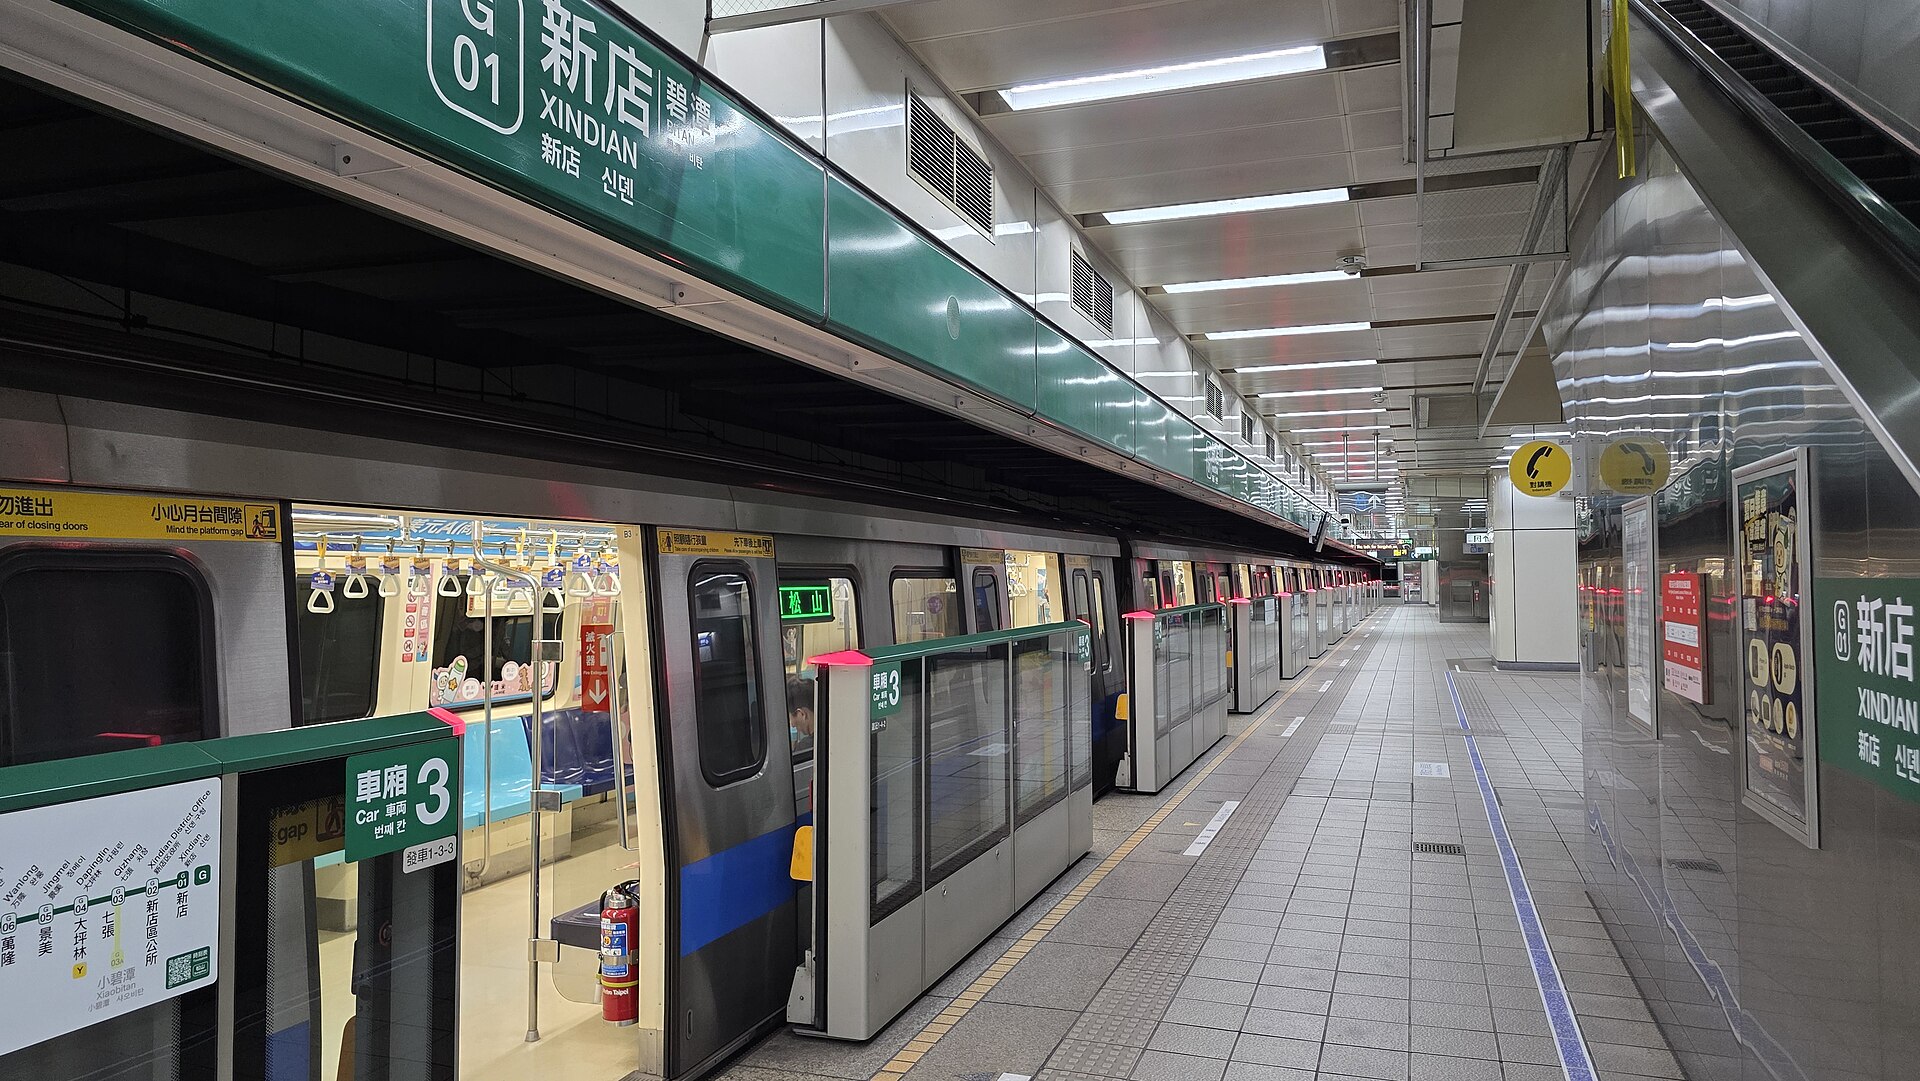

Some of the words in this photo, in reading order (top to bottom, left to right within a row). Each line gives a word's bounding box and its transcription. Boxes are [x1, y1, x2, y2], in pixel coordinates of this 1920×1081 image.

[453, 34, 499, 106] 01
[540, 0, 653, 138] 新店
[539, 88, 638, 170] XINDIAN
[541, 132, 581, 179] 新店
[601, 166, 634, 206] 신덴
[15, 520, 26, 529] of
[27, 520, 61, 532] closing
[62, 521, 89, 531] doors
[151, 503, 243, 524] 小心月台間隙
[166, 525, 185, 534] Mind
[186, 526, 199, 534] the
[200, 526, 230, 536] platform
[231, 529, 244, 537] gap
[624, 530, 632, 538] B3
[789, 590, 823, 615] 松山
[1838, 608, 1846, 630] G
[1837, 632, 1848, 654] 01
[1857, 594, 1914, 682] 新店
[889, 670, 899, 706] 3
[1857, 686, 1919, 735] XINDIAN
[1858, 729, 1880, 768] 新店
[1895, 743, 1920, 784] 신덴
[356, 764, 407, 803] 車廂
[415, 757, 450, 825] 3
[355, 809, 380, 825] Car
[385, 800, 407, 817] 車両
[148, 840, 173, 869] Xindian
[170, 812, 194, 840] District
[191, 790, 211, 812] Office
[278, 823, 308, 845] gap
[374, 821, 394, 840] 번째
[396, 819, 407, 834] 칸
[113, 843, 143, 877] Qizhang
[178, 833, 202, 862] Xindian
[406, 842, 454, 867] 發車1-3-3
[42, 859, 71, 894] Jingmei
[75, 847, 110, 886] Dapinglin
[198, 870, 207, 879] G
[3, 864, 39, 902] Wanlong
[147, 885, 158, 895] 02
[177, 879, 187, 887] 01
[75, 903, 87, 914] 04
[112, 894, 124, 904] 03
[176, 890, 188, 919] 新店
[2, 921, 15, 932] 06
[40, 912, 52, 923] 05
[102, 911, 115, 939] 七張
[38, 926, 52, 957] 景美
[73, 918, 87, 961] 大坪林
[145, 898, 158, 967] 新店區公所
[1, 935, 15, 967] 萬隆
[77, 966, 83, 974] Y
[97, 967, 136, 989] 小碧潭
[96, 982, 136, 1000] Xiaobitan
